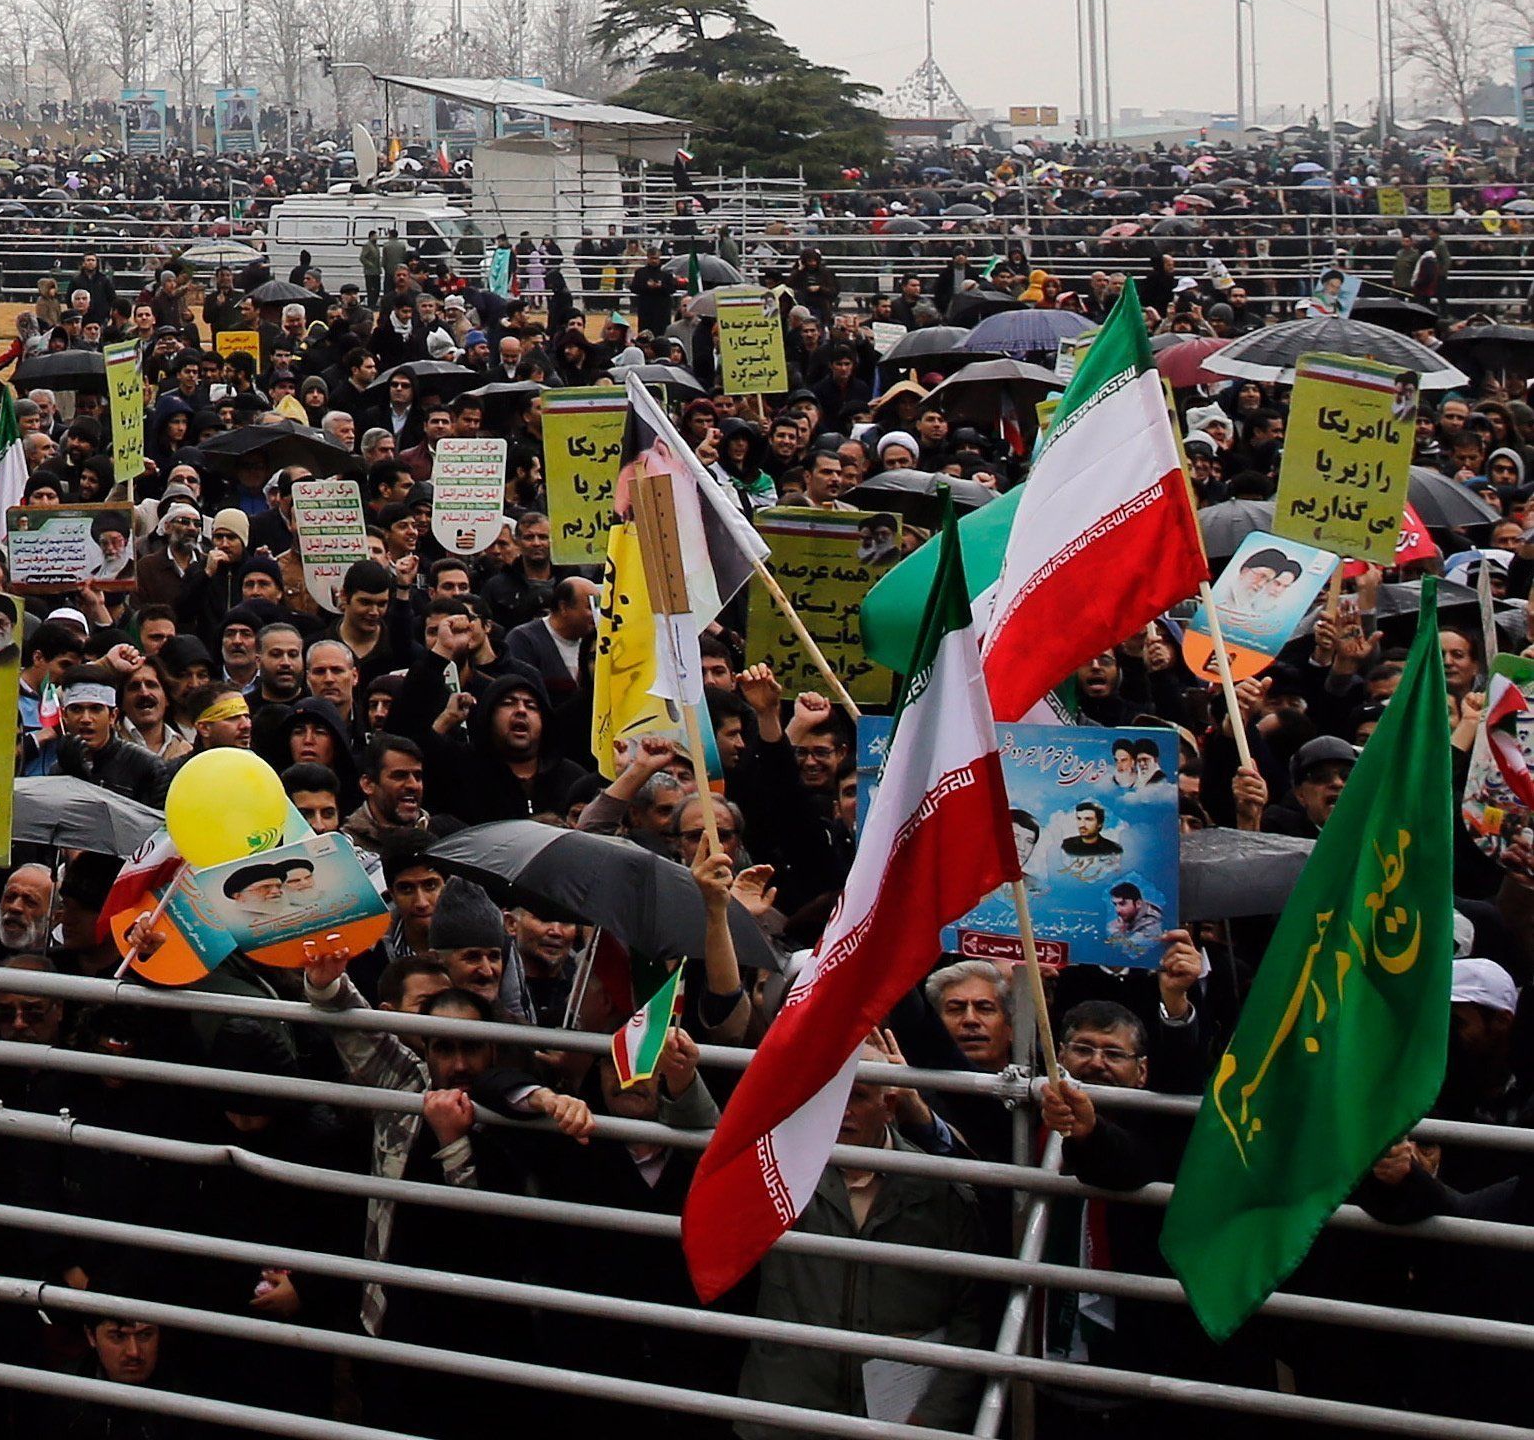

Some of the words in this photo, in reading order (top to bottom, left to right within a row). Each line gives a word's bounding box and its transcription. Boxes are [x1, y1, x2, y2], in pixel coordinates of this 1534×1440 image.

[732, 320, 752, 332] عرصه
[754, 320, 769, 329] همه
[769, 319, 779, 331] در
[731, 368, 747, 382] کرد
[749, 366, 779, 381] خواهیم
[1317, 407, 1382, 444] امریکا
[1385, 420, 1400, 445] ما
[567, 436, 621, 463] مریکا
[1316, 448, 1331, 482] پا
[1335, 462, 1370, 489] زیر
[1376, 461, 1391, 493] را
[573, 474, 589, 502] پا
[593, 479, 613, 501] یر
[1290, 495, 1368, 524] گذاریم
[1368, 515, 1396, 535] می
[1364, 828, 1422, 975] مطیع
